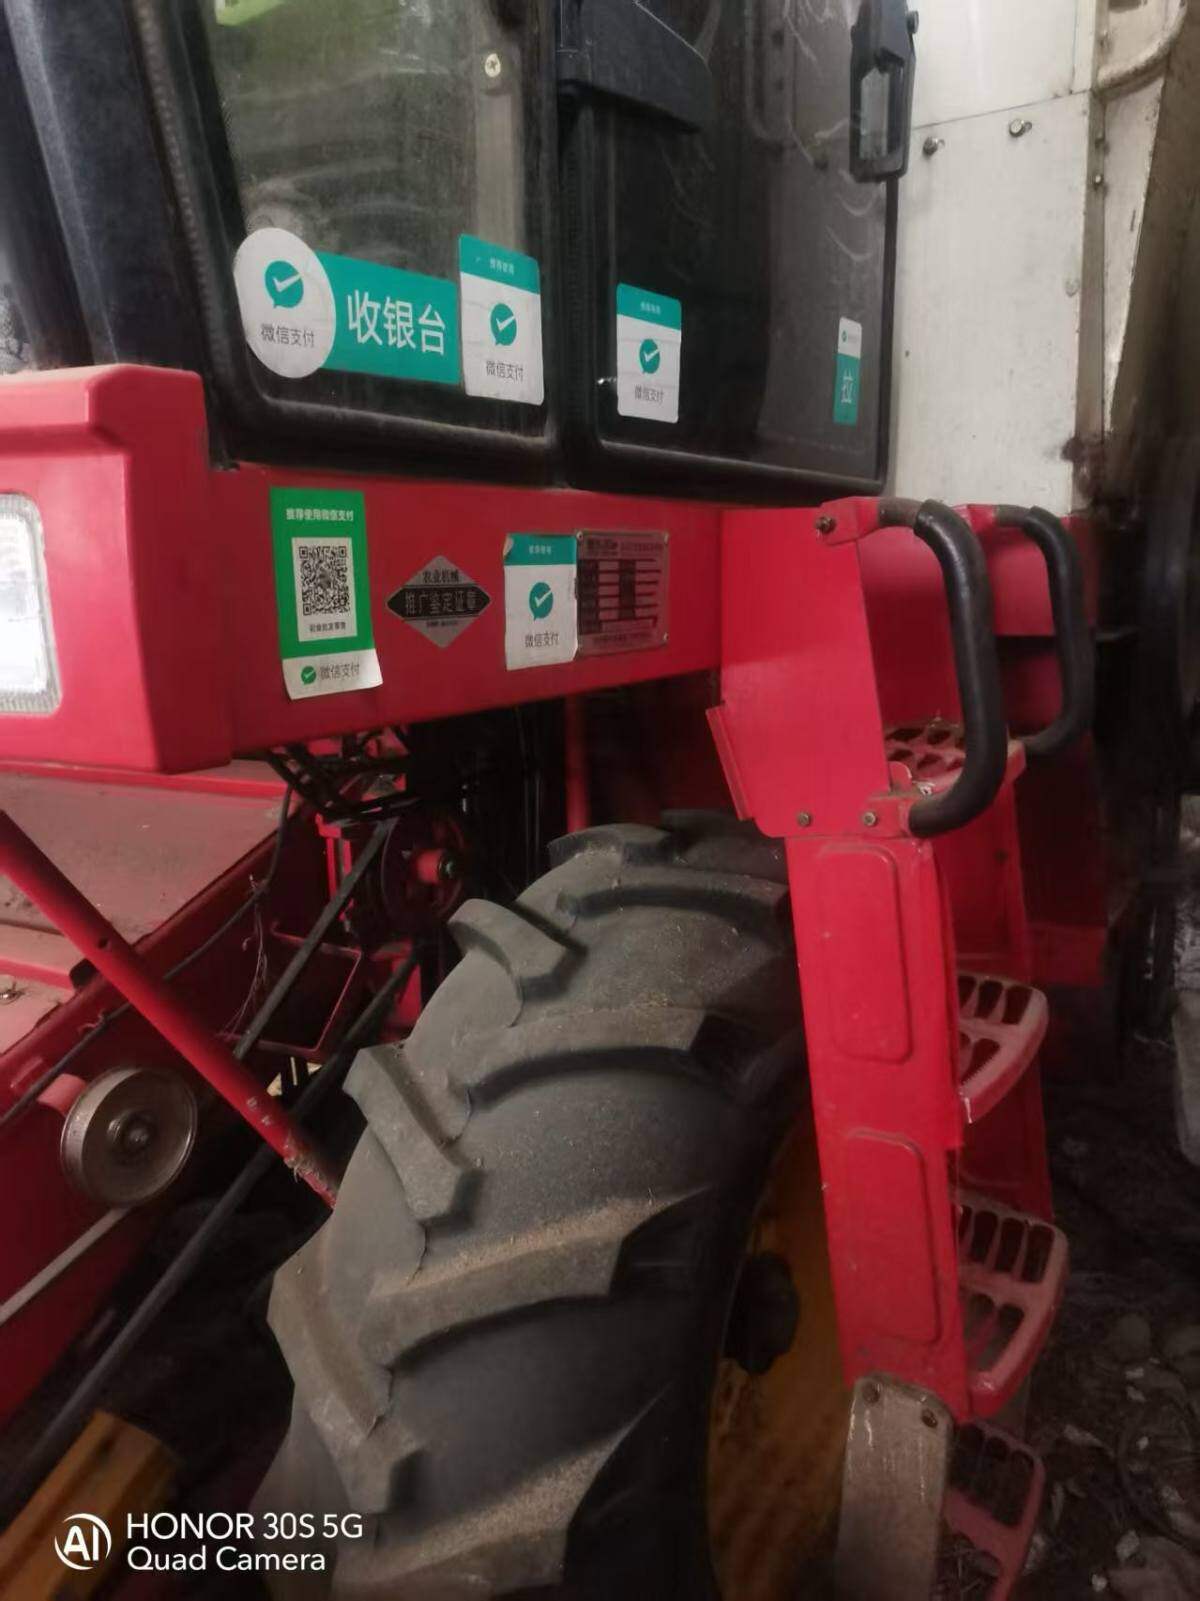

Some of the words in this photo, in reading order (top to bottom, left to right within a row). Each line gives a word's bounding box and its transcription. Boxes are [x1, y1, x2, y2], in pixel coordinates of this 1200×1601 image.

[347, 289, 446, 355] 收银台
[260, 322, 315, 348] 微信支付
[485, 359, 524, 382] 微信支付
[634, 385, 664, 406] 微信支付
[286, 507, 355, 521] 推荐使用微信支付
[422, 567, 460, 584] 农业机械
[524, 629, 560, 649] 微信支付
[319, 662, 361, 682] 微信支付
